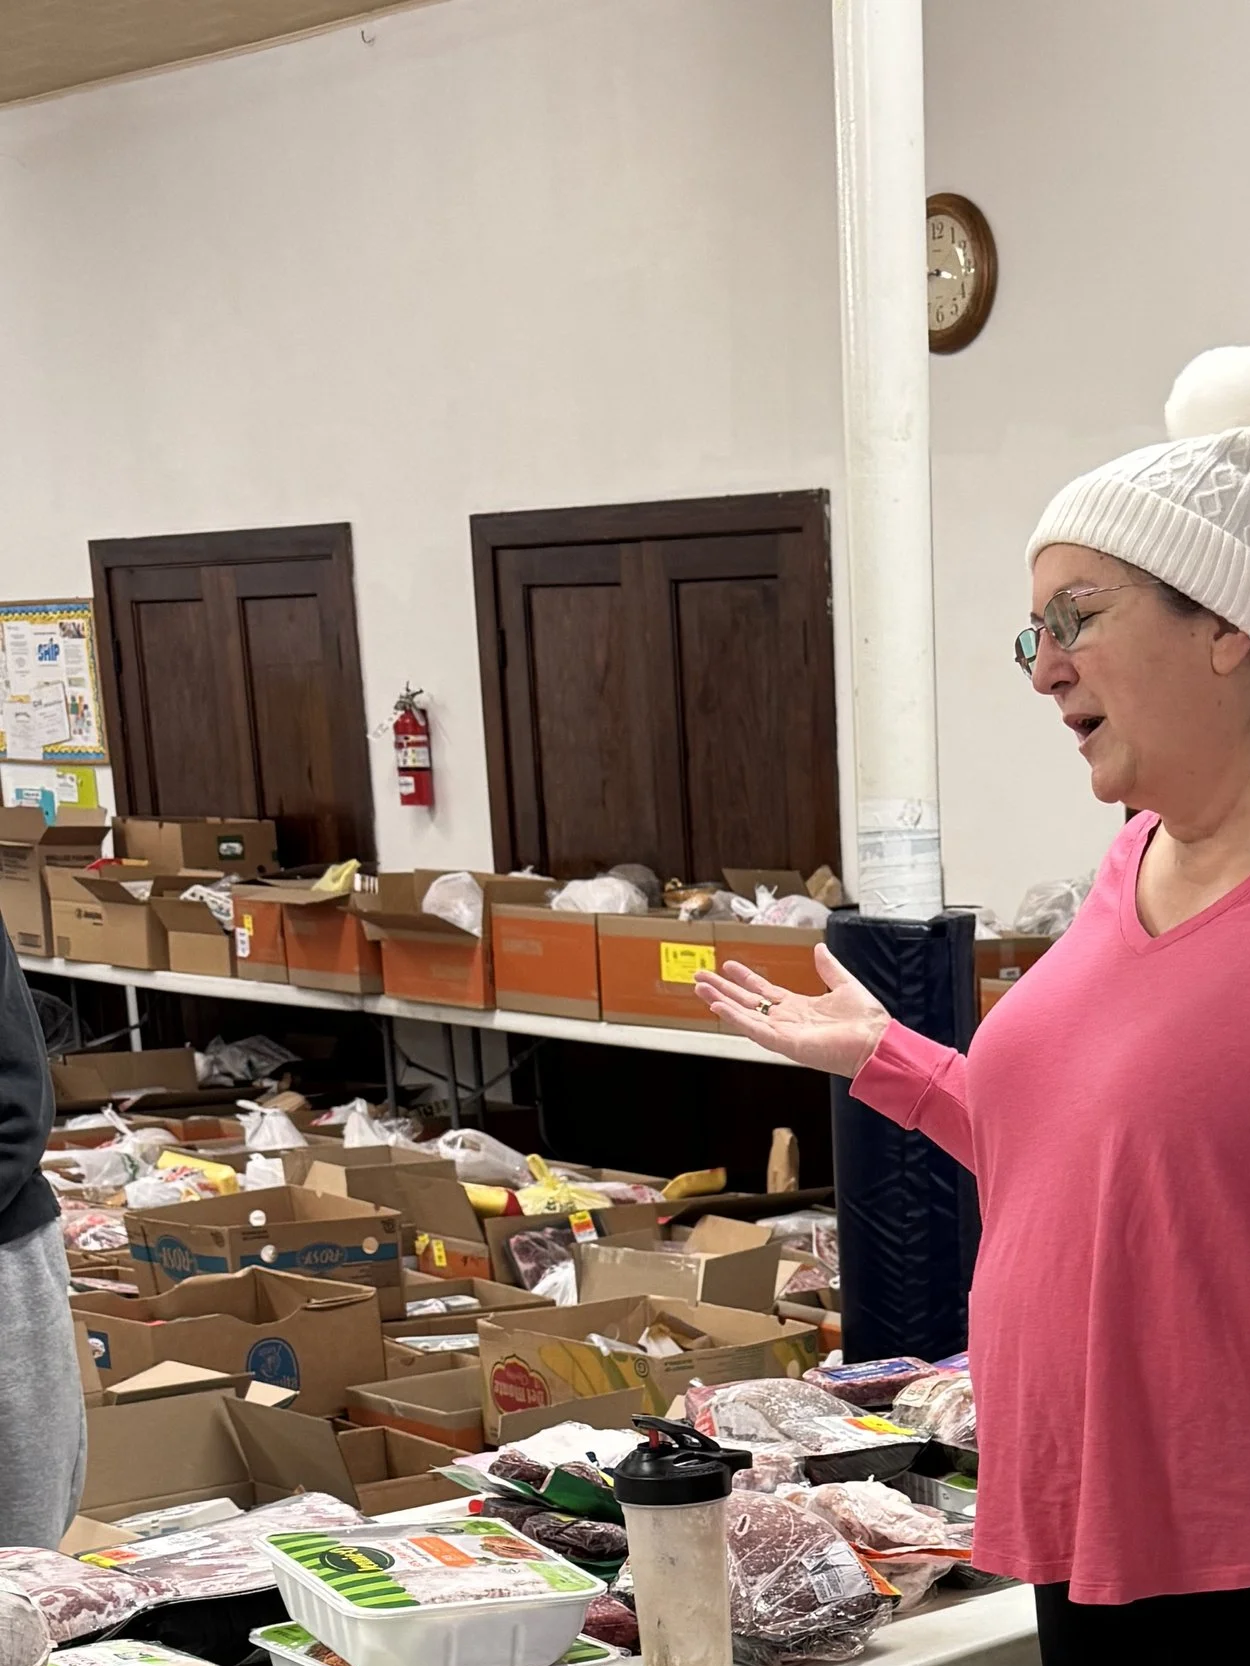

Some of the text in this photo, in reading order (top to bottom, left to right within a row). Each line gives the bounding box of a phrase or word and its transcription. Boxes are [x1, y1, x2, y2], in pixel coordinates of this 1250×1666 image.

[931, 222, 943, 240] 12
[935, 306, 945, 323] 6
[950, 298, 959, 316] 5
[304, 1248, 341, 1266] ROSY
